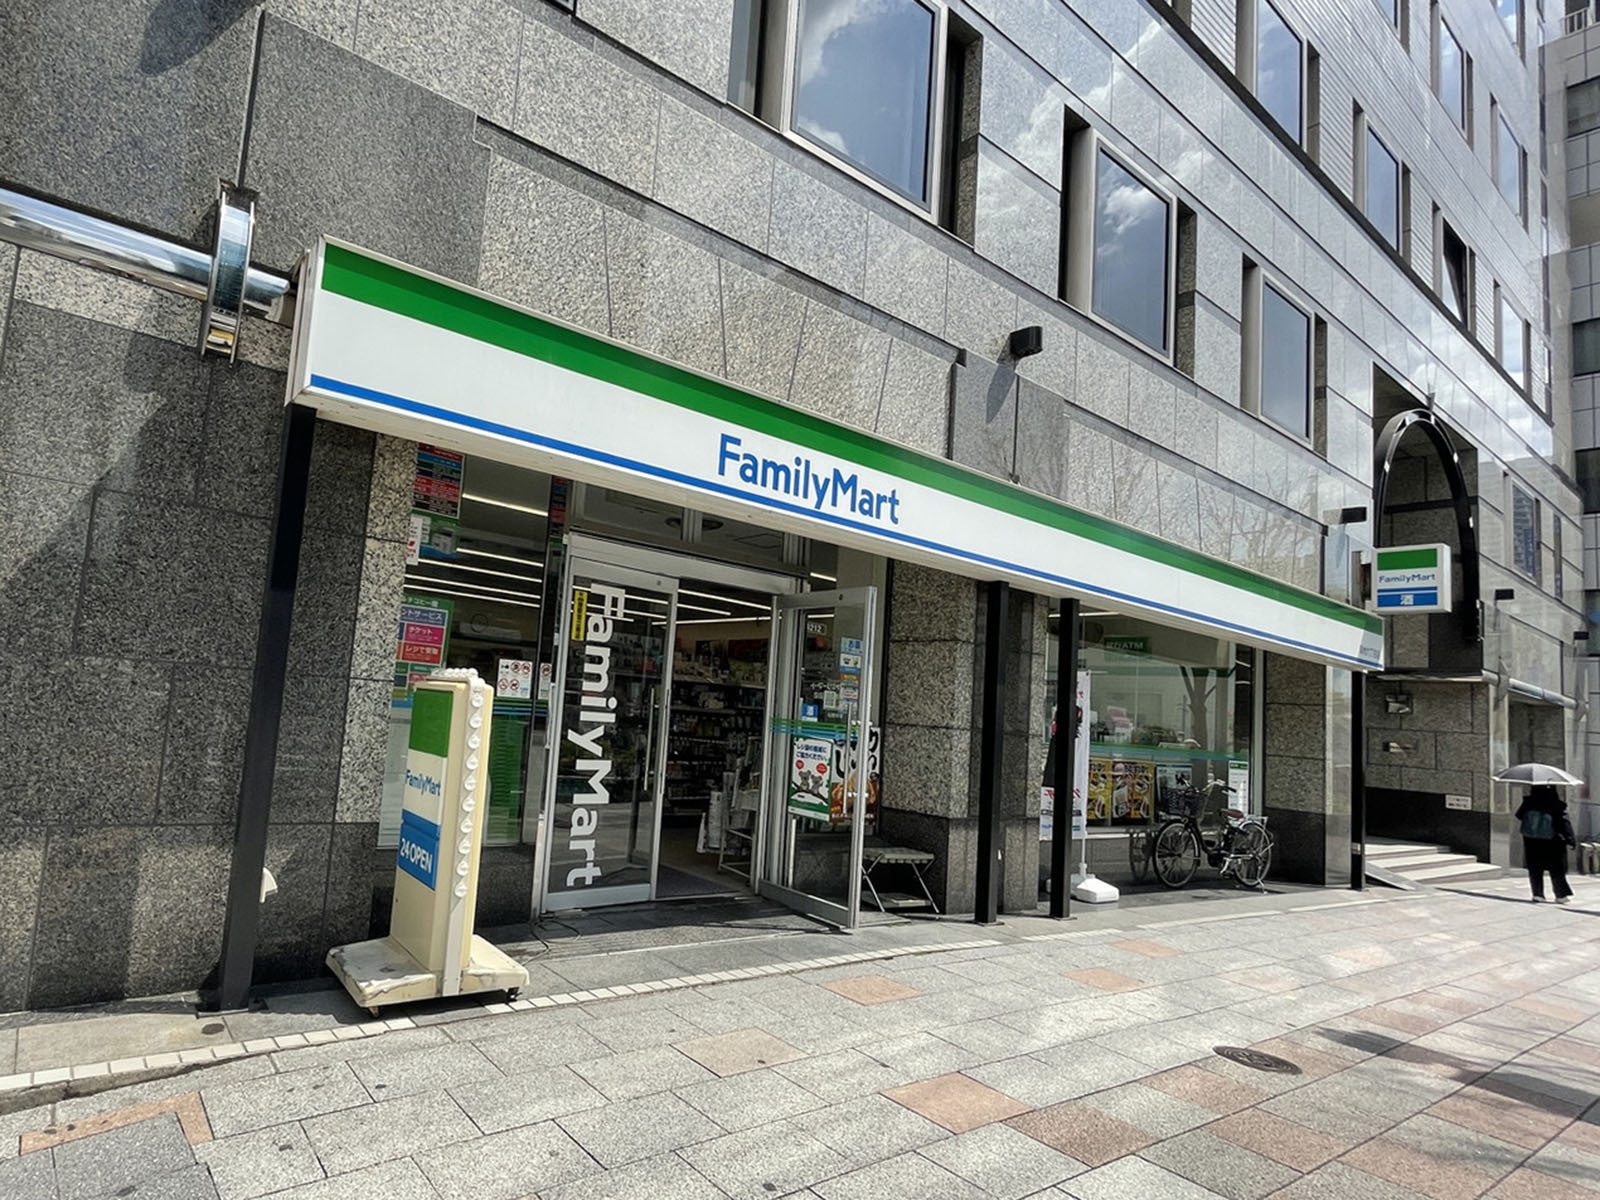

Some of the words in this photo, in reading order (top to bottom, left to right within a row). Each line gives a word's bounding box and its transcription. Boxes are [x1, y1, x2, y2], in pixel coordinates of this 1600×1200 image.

[717, 433, 900, 524] FamilyMart
[1379, 573, 1436, 583] FamilyMart
[563, 583, 626, 888] FamilyMart
[405, 769, 441, 797] FamilyMart
